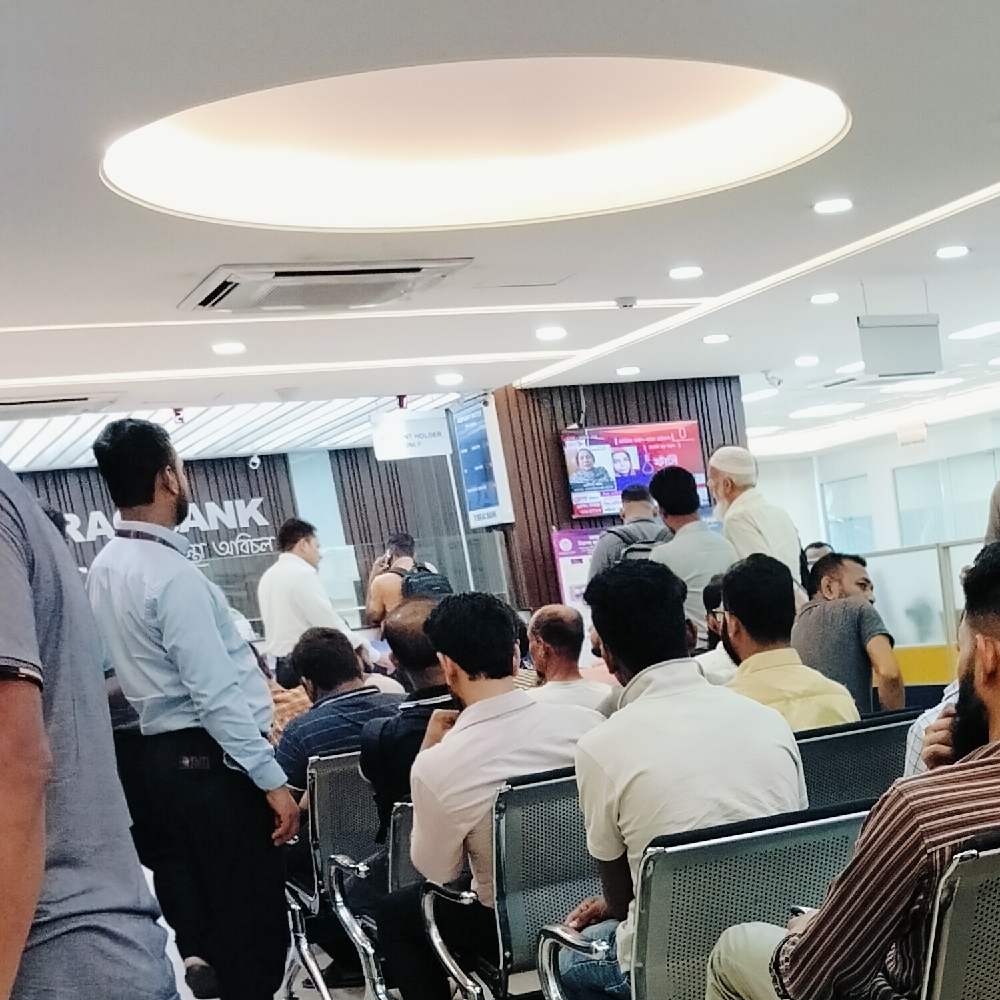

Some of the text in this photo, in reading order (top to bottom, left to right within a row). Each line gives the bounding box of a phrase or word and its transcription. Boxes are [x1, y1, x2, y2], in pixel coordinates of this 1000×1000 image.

[415, 431, 442, 439] HOLDER
[64, 497, 270, 543] RA ANK
